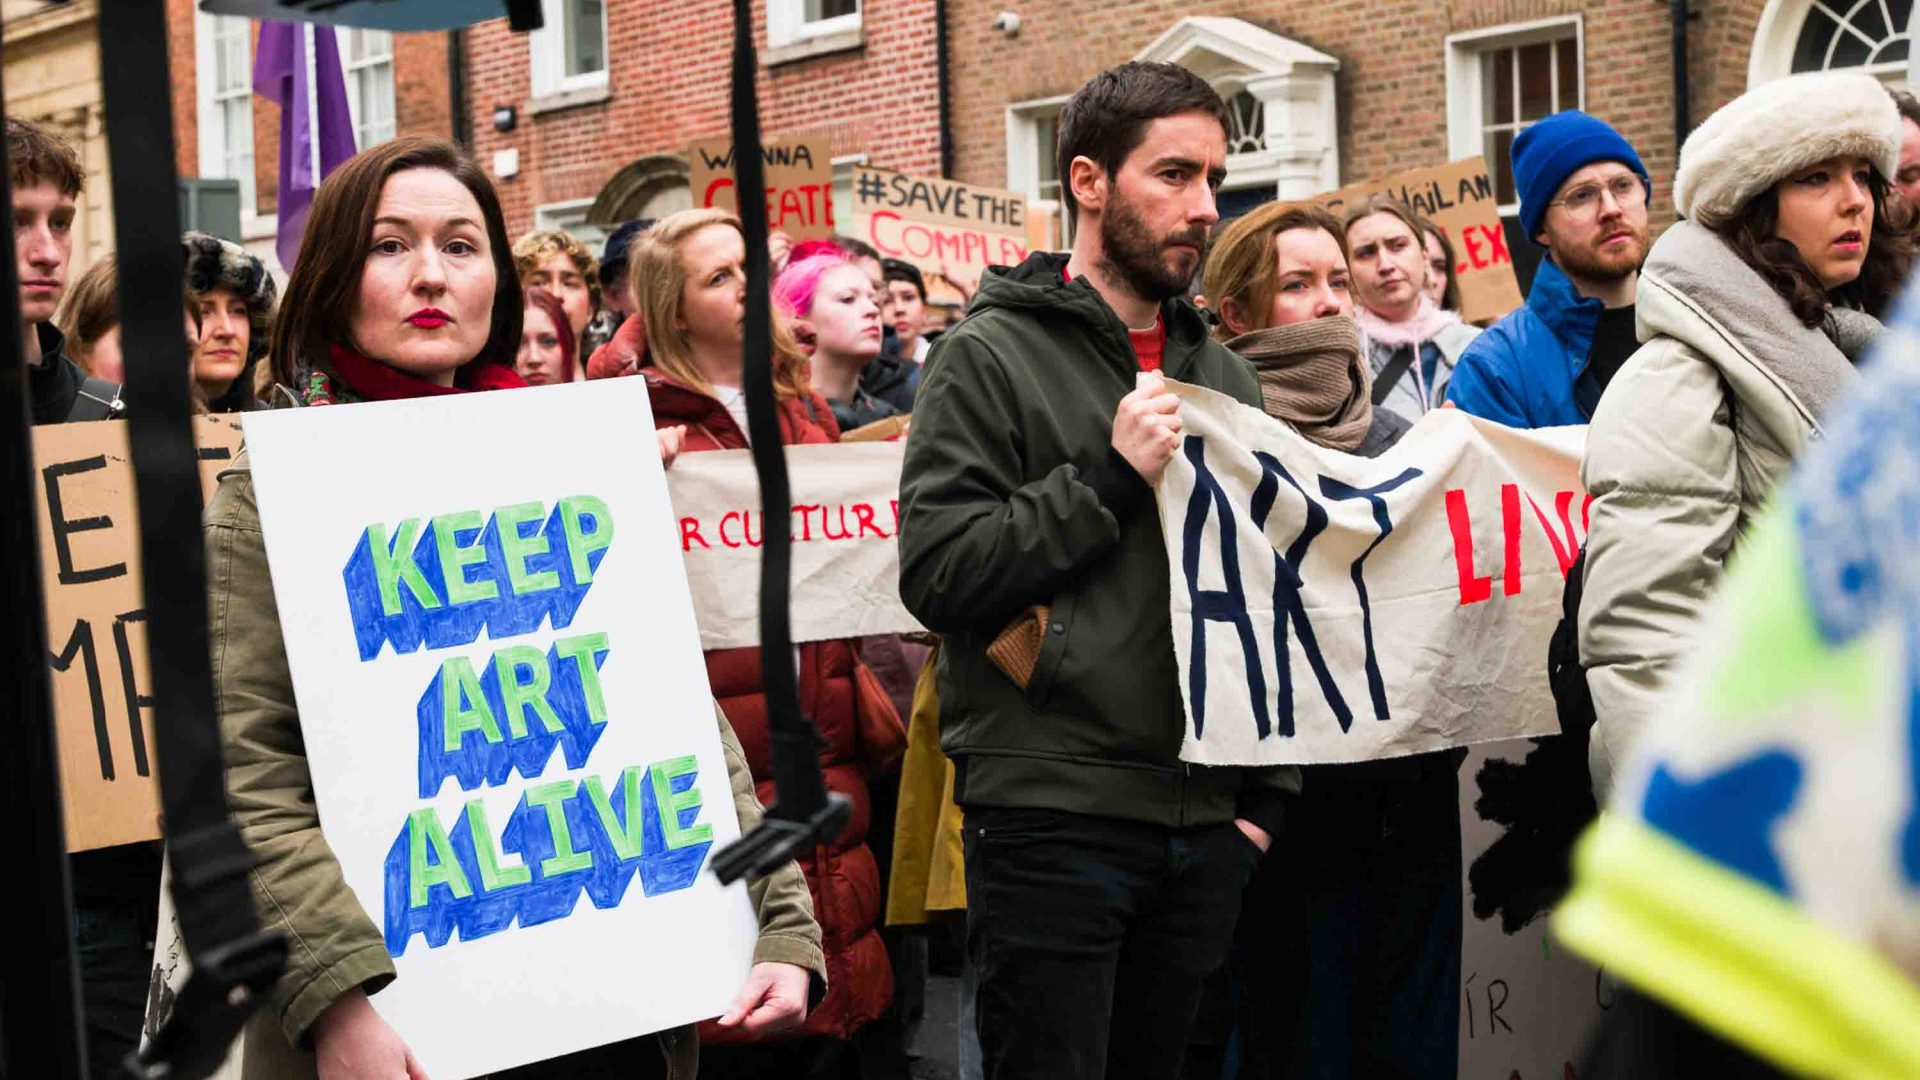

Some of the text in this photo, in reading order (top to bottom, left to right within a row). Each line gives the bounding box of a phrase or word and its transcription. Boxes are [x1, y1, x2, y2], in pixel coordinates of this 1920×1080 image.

[698, 143, 813, 171] WNNA
[704, 177, 834, 230] CEATE
[857, 172, 1023, 226] #SAVE THE
[1459, 174, 1493, 204] AN
[719, 500, 899, 549] CUTUR
[343, 494, 614, 662] KEEP
[1181, 435, 1594, 741] ART LIV
[417, 631, 611, 799] ART
[384, 754, 714, 958] ALIVE
